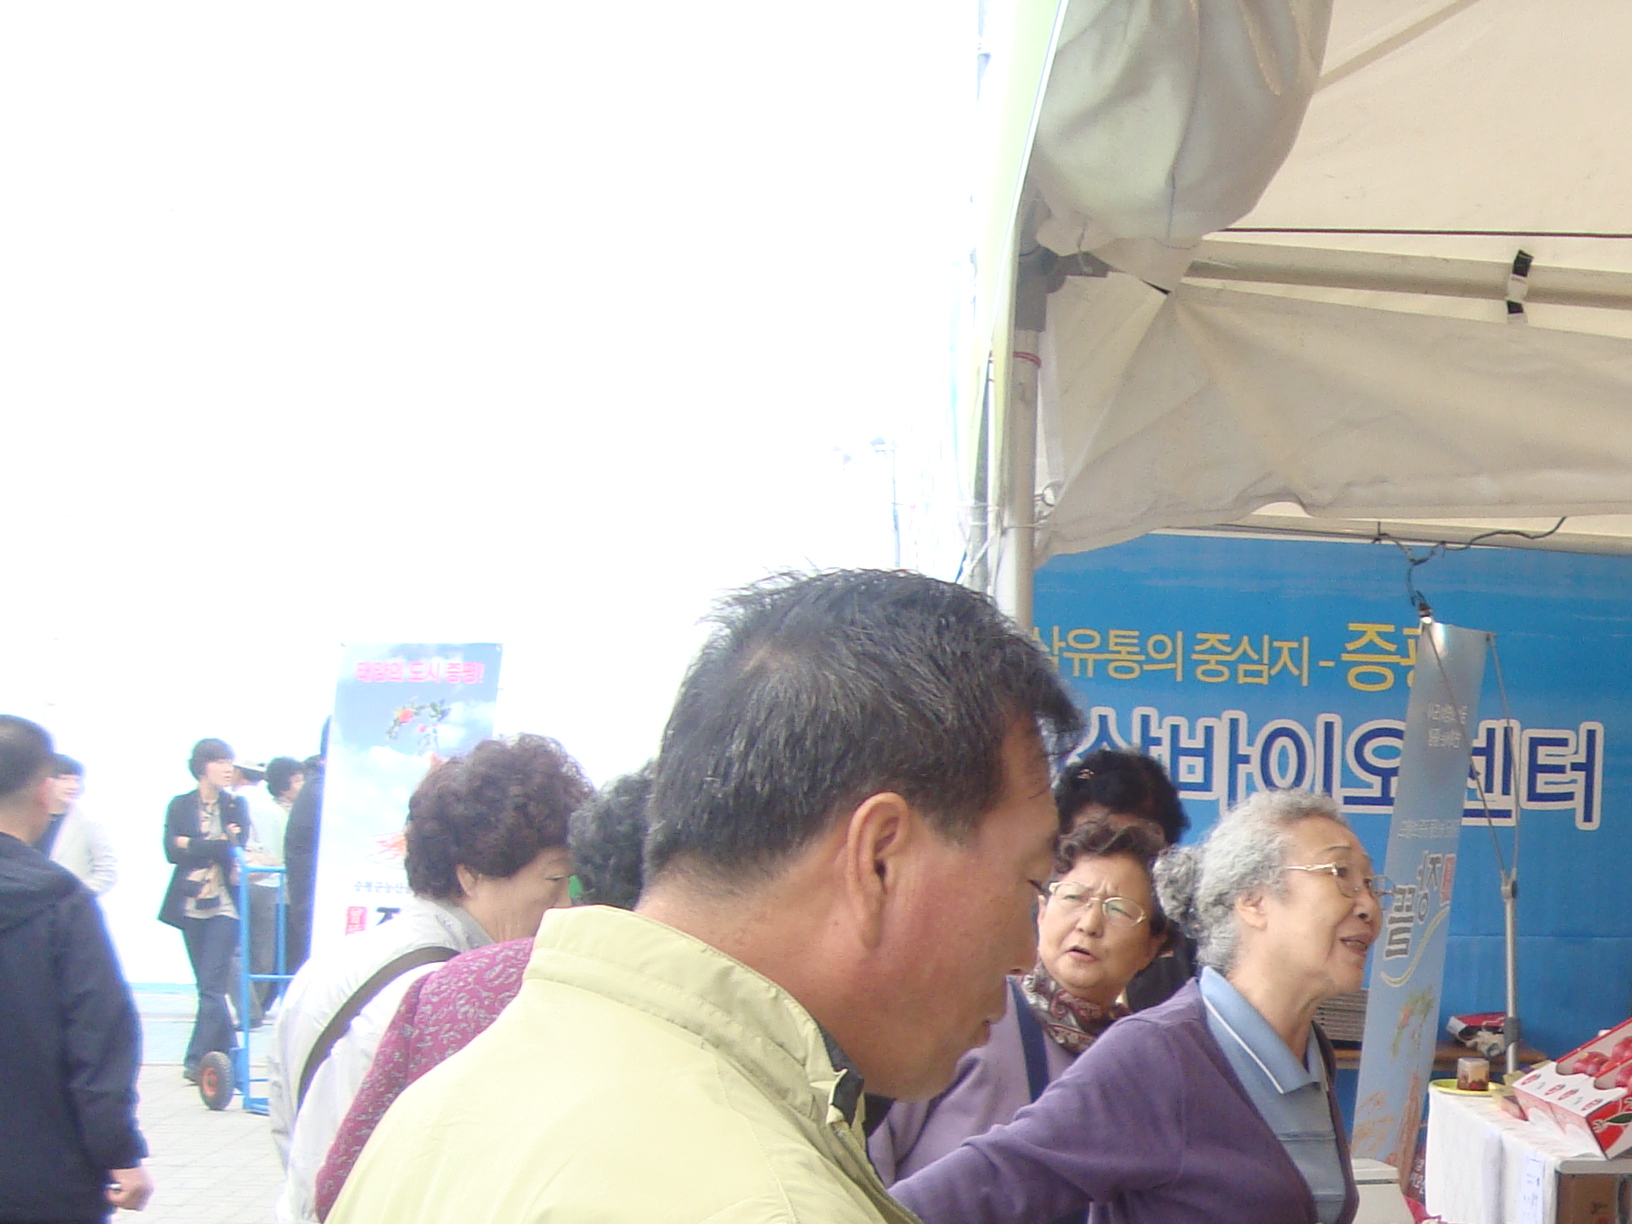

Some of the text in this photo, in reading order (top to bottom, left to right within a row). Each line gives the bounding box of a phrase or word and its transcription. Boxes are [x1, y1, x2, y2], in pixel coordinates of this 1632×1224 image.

[356, 661, 404, 682] 태양의
[407, 661, 440, 684] 도시
[1190, 632, 1310, 687] 중심지
